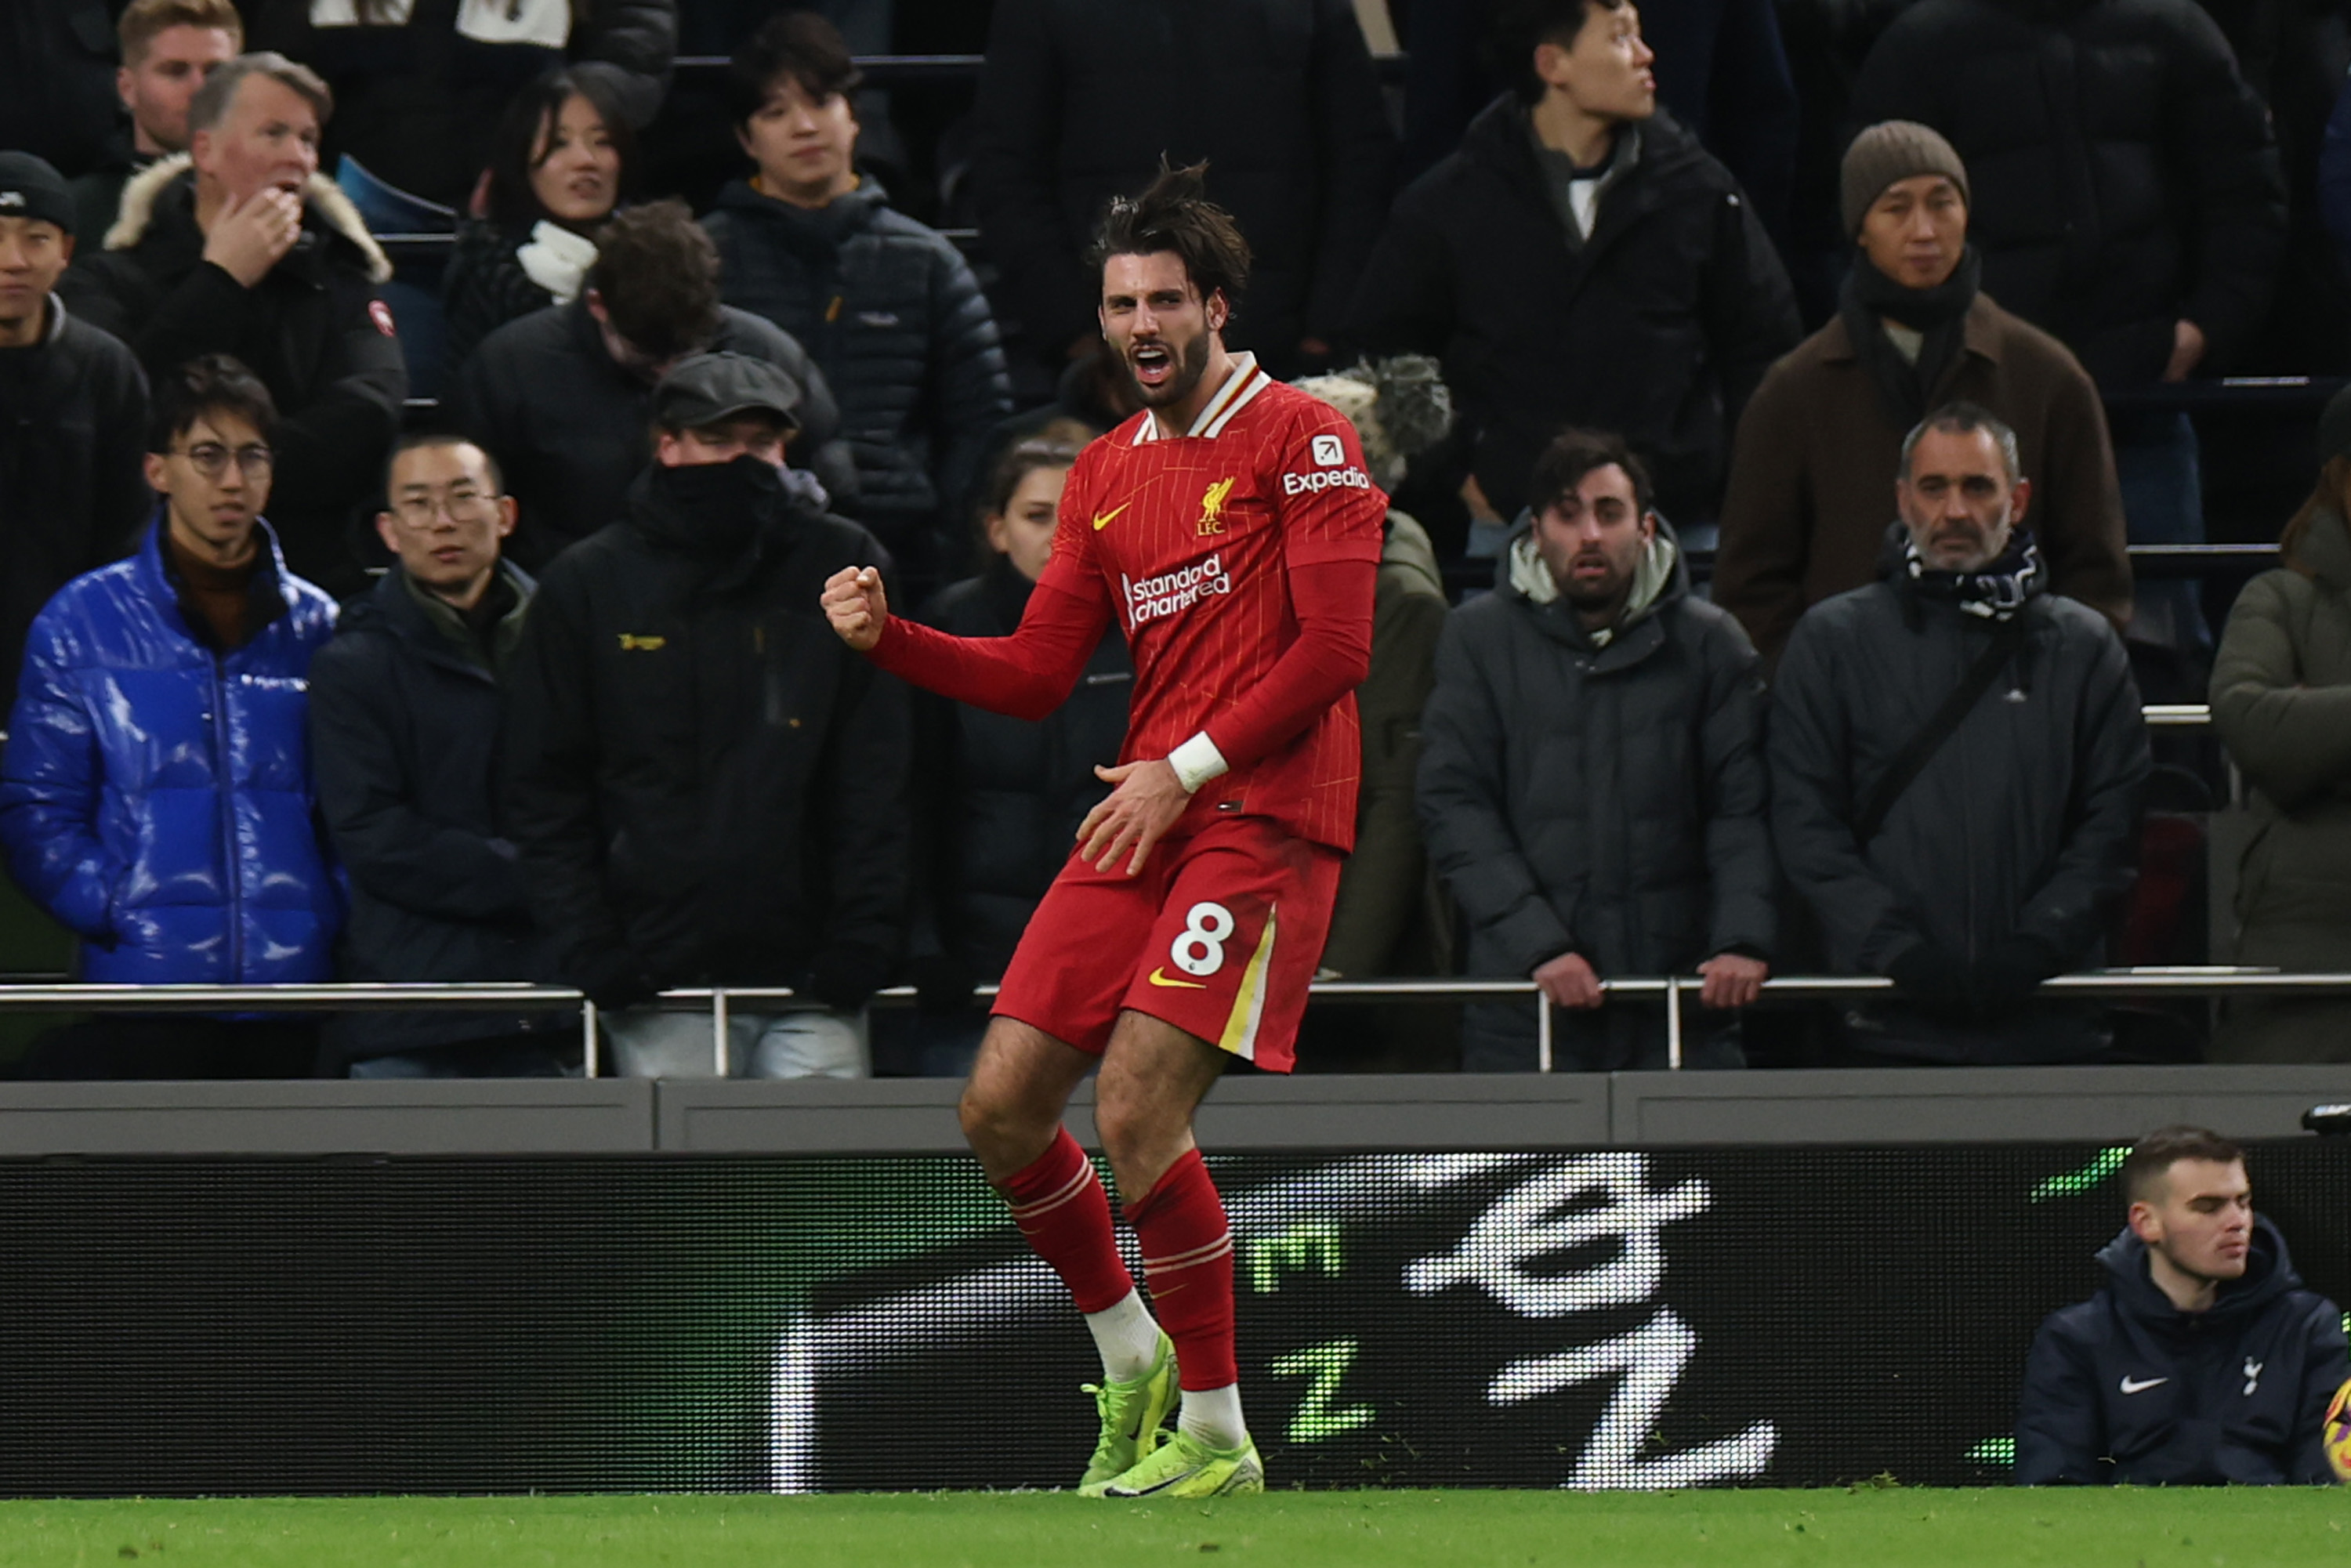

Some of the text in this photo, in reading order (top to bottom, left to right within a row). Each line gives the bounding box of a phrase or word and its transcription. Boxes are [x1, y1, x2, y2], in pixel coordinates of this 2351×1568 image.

[1283, 466, 1370, 495] Expedia
[1133, 553, 1221, 601] standad
[1171, 901, 1234, 976] 8
